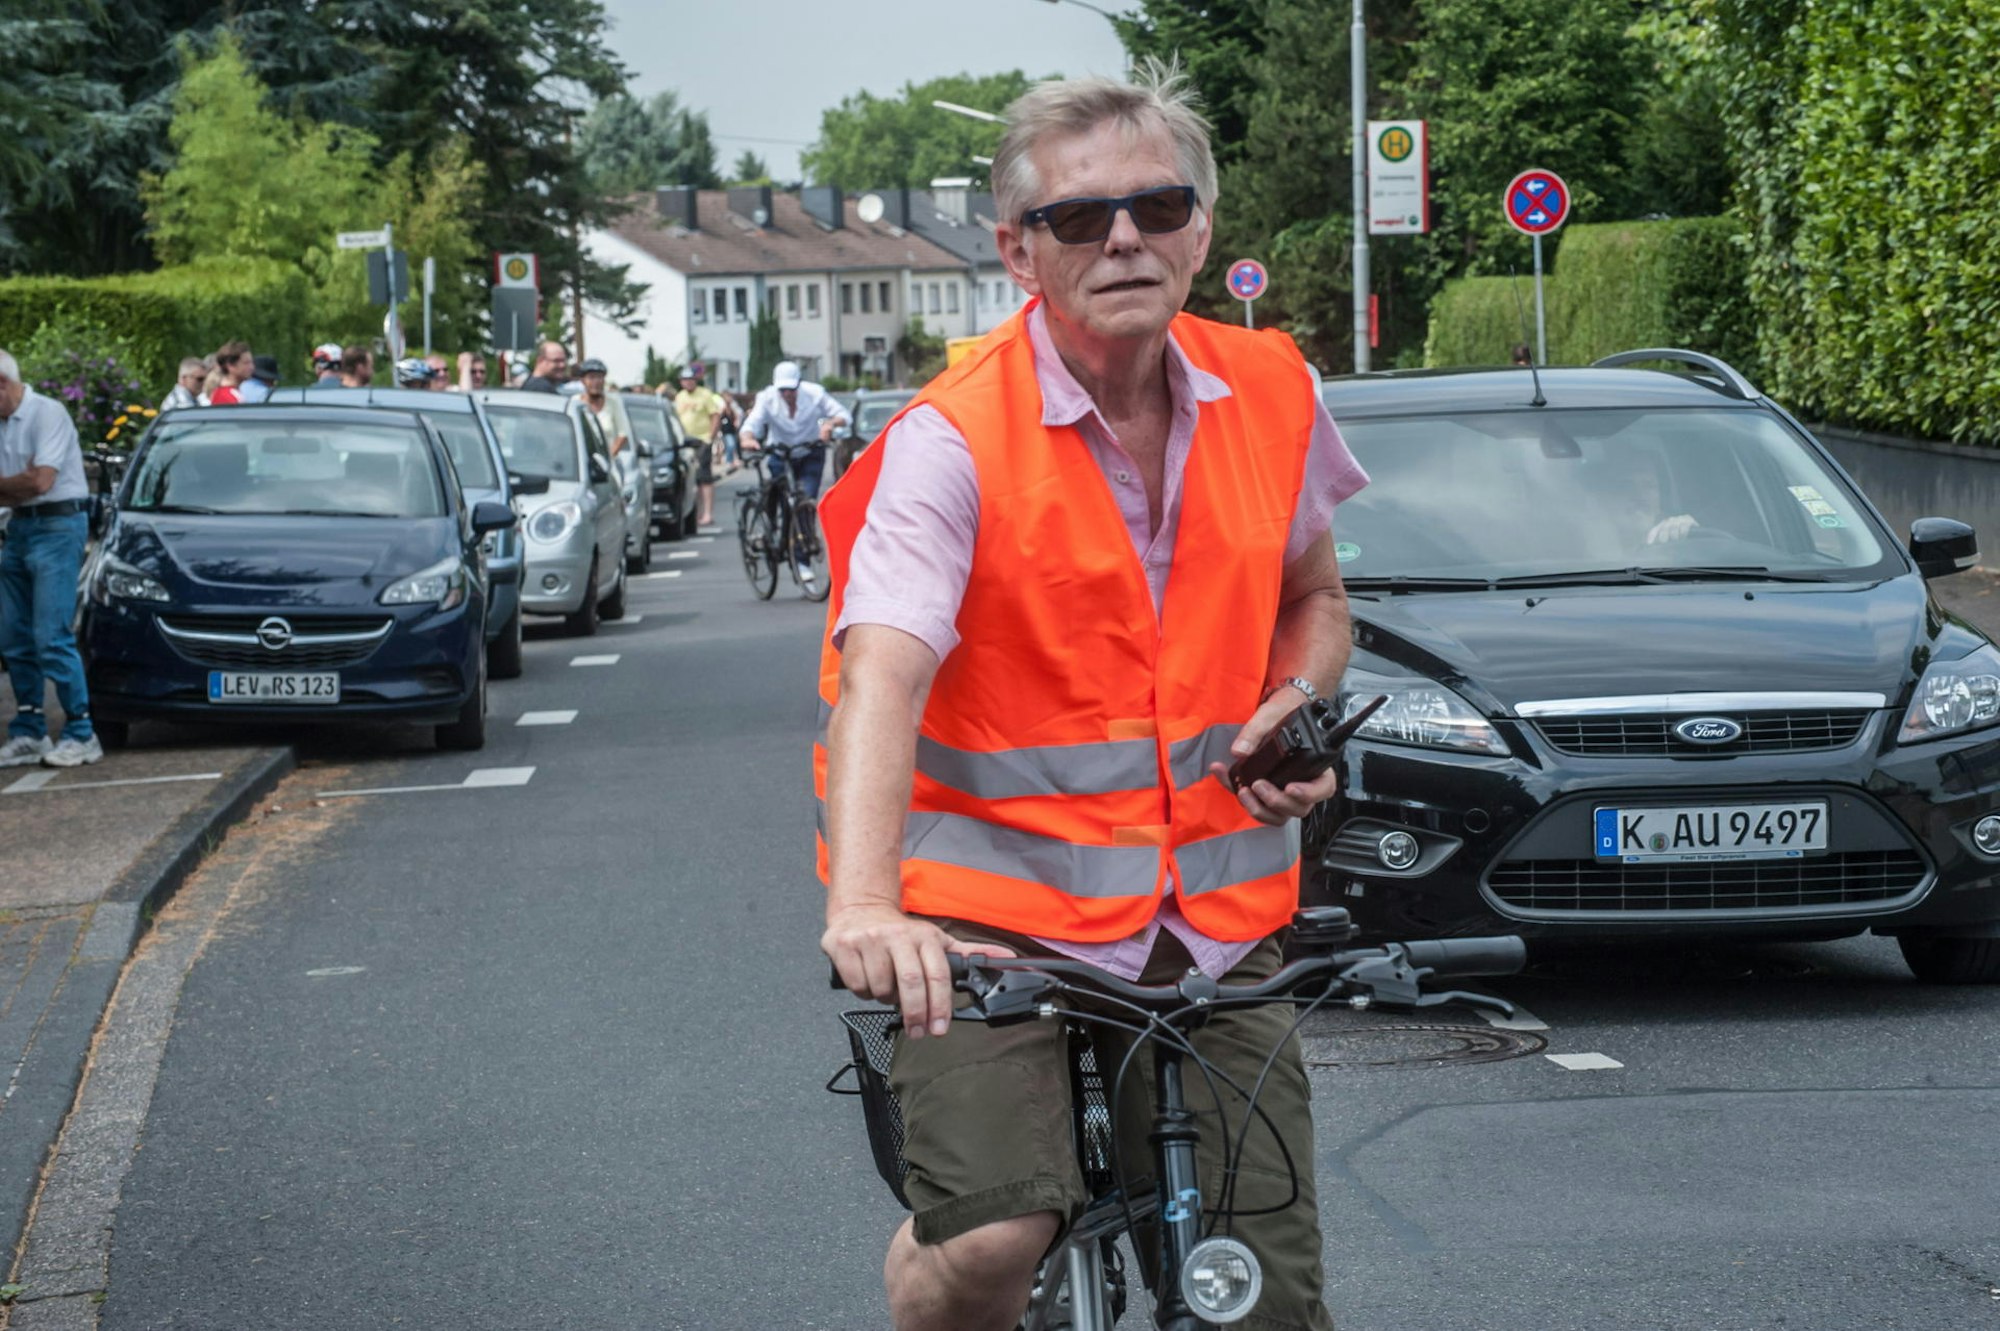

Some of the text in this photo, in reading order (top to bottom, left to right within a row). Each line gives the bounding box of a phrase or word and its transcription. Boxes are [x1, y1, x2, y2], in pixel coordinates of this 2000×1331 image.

[1388, 133, 1404, 156] H
[223, 676, 259, 696] LEV
[272, 676, 296, 696] RS
[301, 676, 335, 696] 123
[1691, 723, 1727, 738] Ford
[1622, 808, 1820, 849] K AU 9497
[1603, 837, 1612, 848] D
